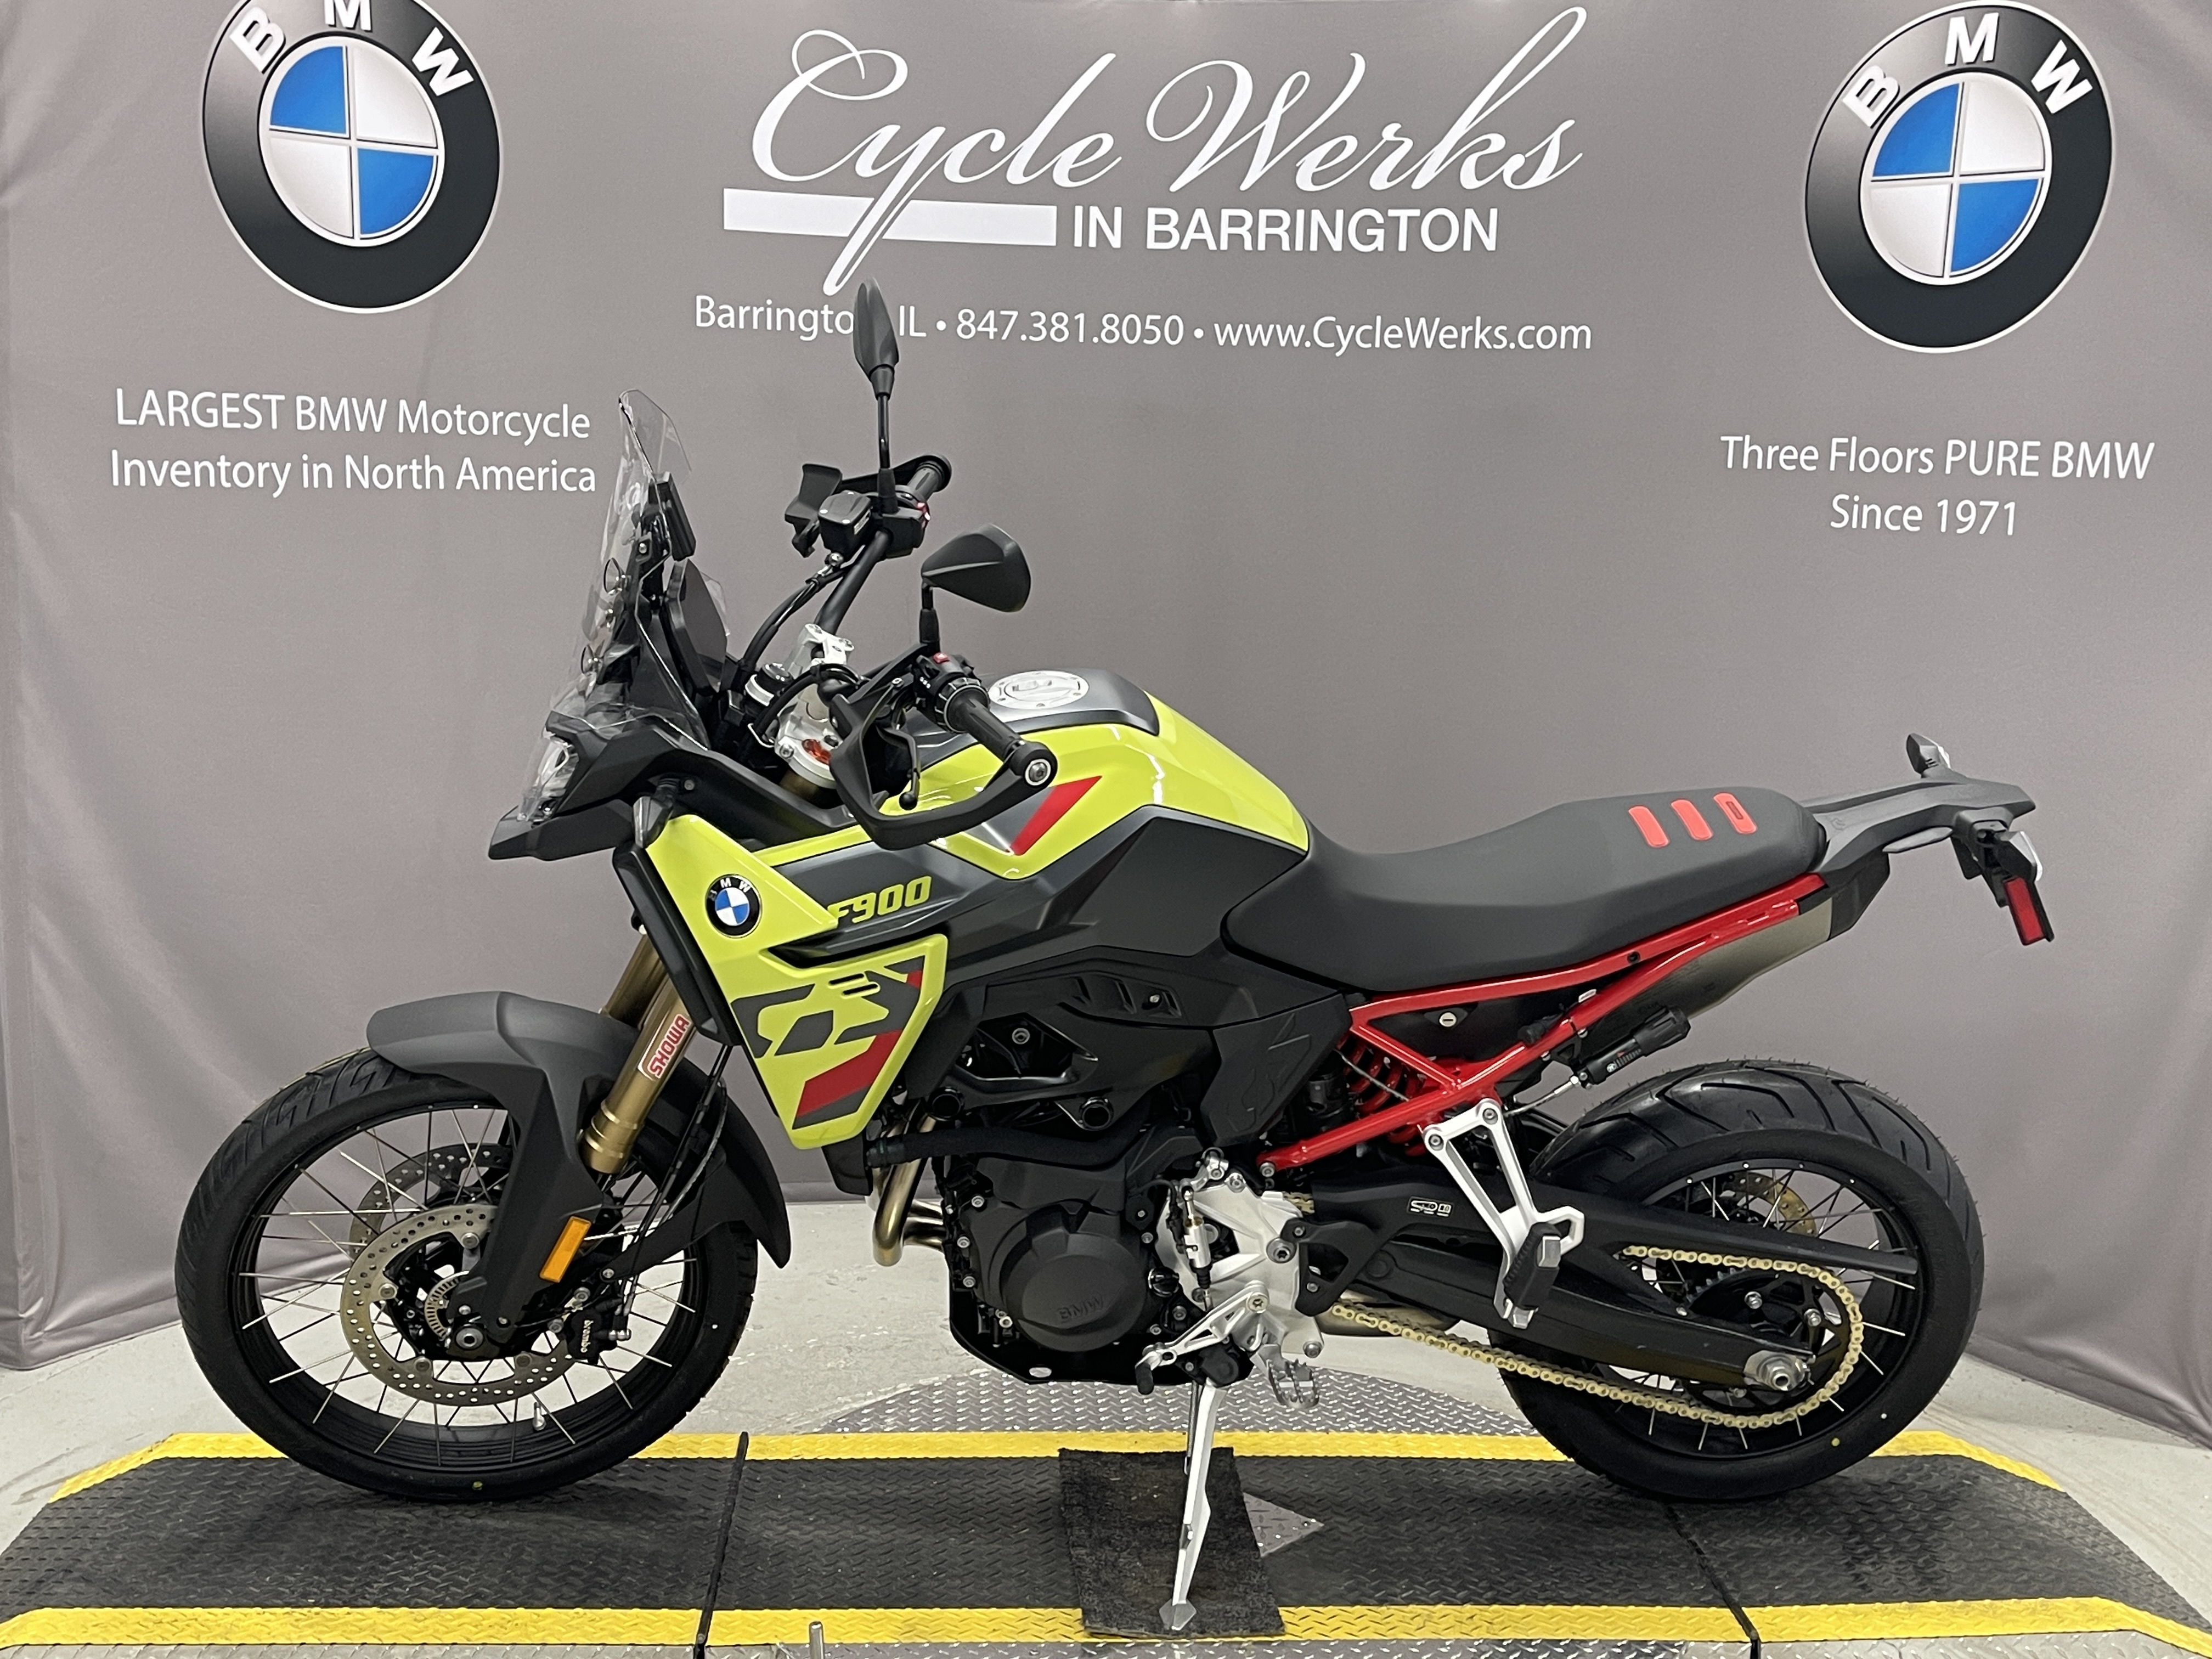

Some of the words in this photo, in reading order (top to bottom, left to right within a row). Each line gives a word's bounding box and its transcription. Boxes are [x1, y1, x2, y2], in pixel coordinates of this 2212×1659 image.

[229, 0, 475, 97] BMW
[1841, 12, 2093, 128] BMW
[752, 30, 1122, 296] Cycle
[1146, 6, 1588, 193] Werks
[1074, 205, 1122, 249] IN
[1146, 207, 1498, 253] BARRINGTON
[696, 295, 855, 342] Barringto
[899, 304, 927, 337] IL
[956, 308, 1184, 346] 847.381.8050
[1214, 314, 1592, 357] www.CycleWerks.com
[116, 387, 286, 430] LARGEST
[295, 395, 388, 433] BMW
[398, 399, 591, 447] Motorcycle
[111, 449, 292, 499] Inventory
[301, 453, 333, 489] in
[345, 454, 445, 490] North
[455, 456, 596, 492] America
[1720, 434, 1819, 471] Three
[1829, 436, 1934, 475] Floors
[1945, 439, 2041, 477] PURE
[2051, 441, 2155, 480] BMW
[1830, 493, 1923, 532] Since
[1937, 499, 2016, 536] 1971
[708, 877, 752, 901] BMW
[827, 876, 932, 923] F900
[647, 1013, 691, 1079] SHOWA
[1056, 1295, 1105, 1324] BMW
[580, 1320, 594, 1353] brembo
